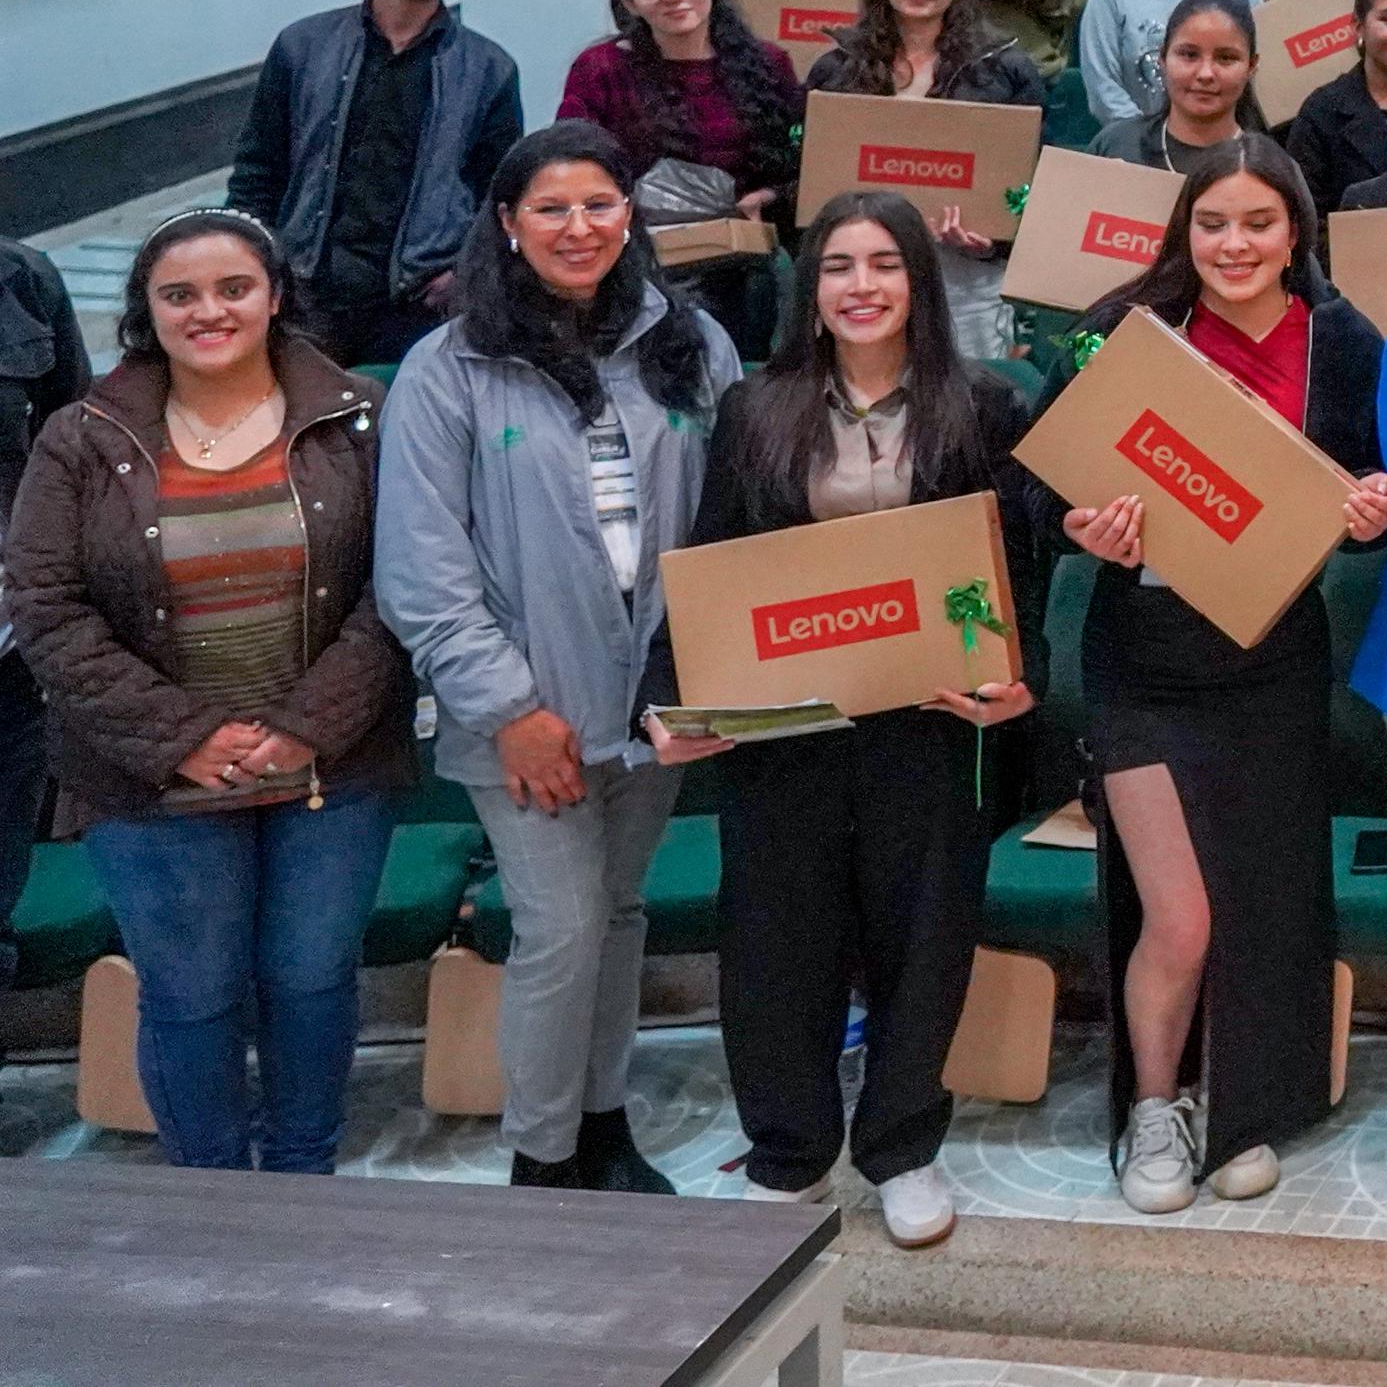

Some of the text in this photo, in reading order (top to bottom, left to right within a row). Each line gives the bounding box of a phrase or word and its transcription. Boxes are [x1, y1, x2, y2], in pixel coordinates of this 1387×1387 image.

[1295, 24, 1352, 58] Leno
[869, 154, 963, 180] Lenovo
[1135, 426, 1240, 522] Lenovo
[768, 599, 904, 645] Lenovo
